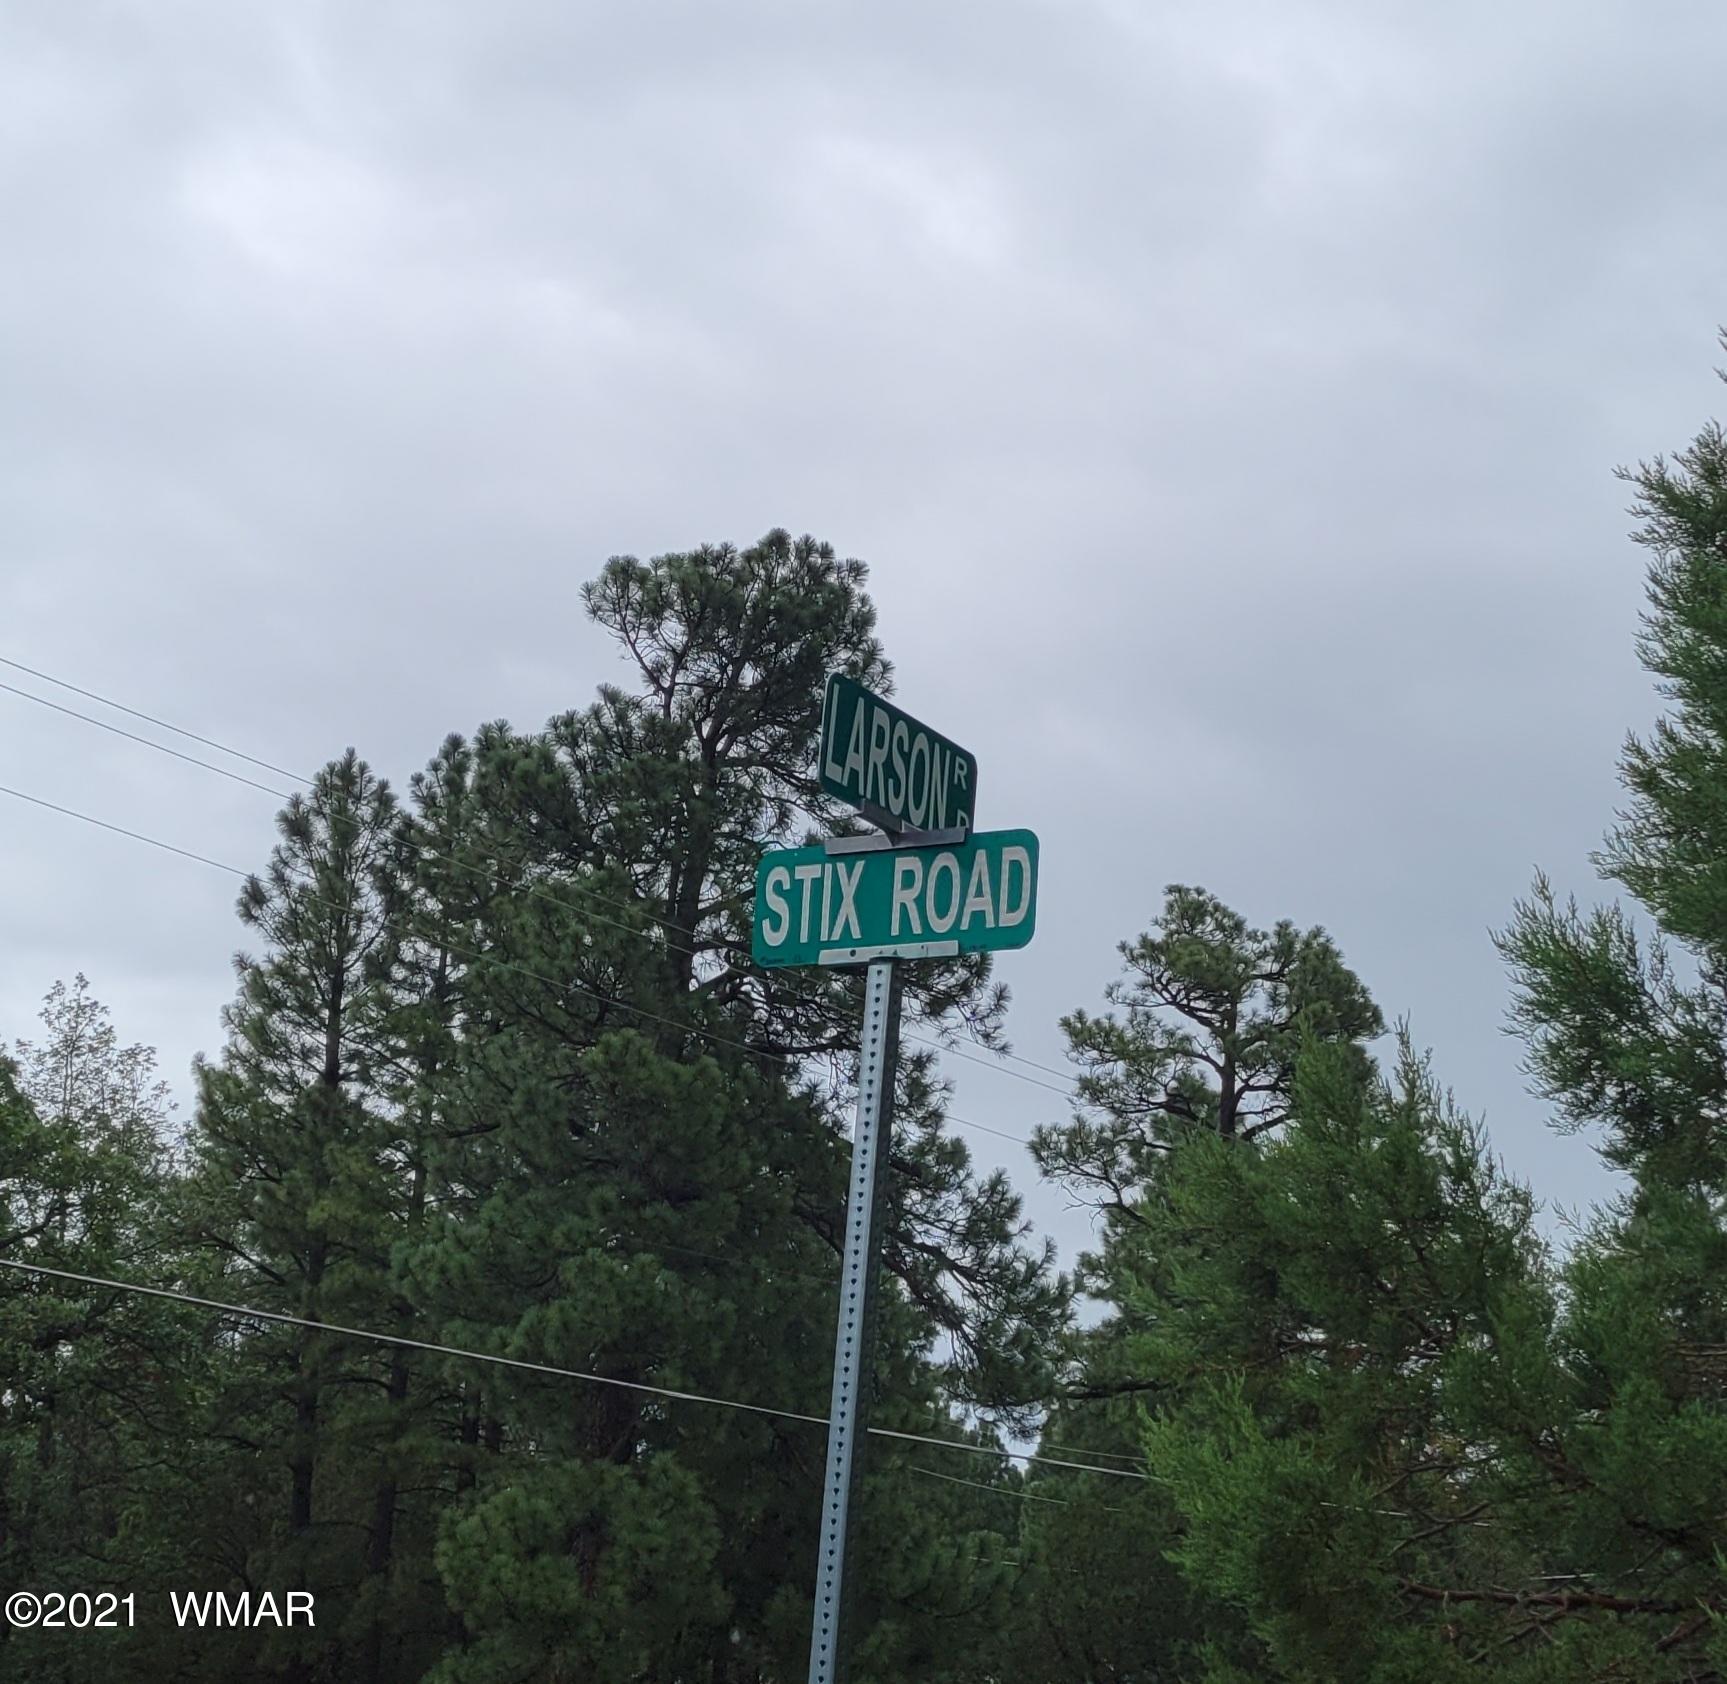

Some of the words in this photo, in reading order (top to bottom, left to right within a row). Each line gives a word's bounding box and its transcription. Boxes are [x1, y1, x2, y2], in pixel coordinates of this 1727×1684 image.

[825, 683, 950, 831] LARSON
[762, 860, 865, 947] STIX
[890, 846, 1031, 936] ROAD
